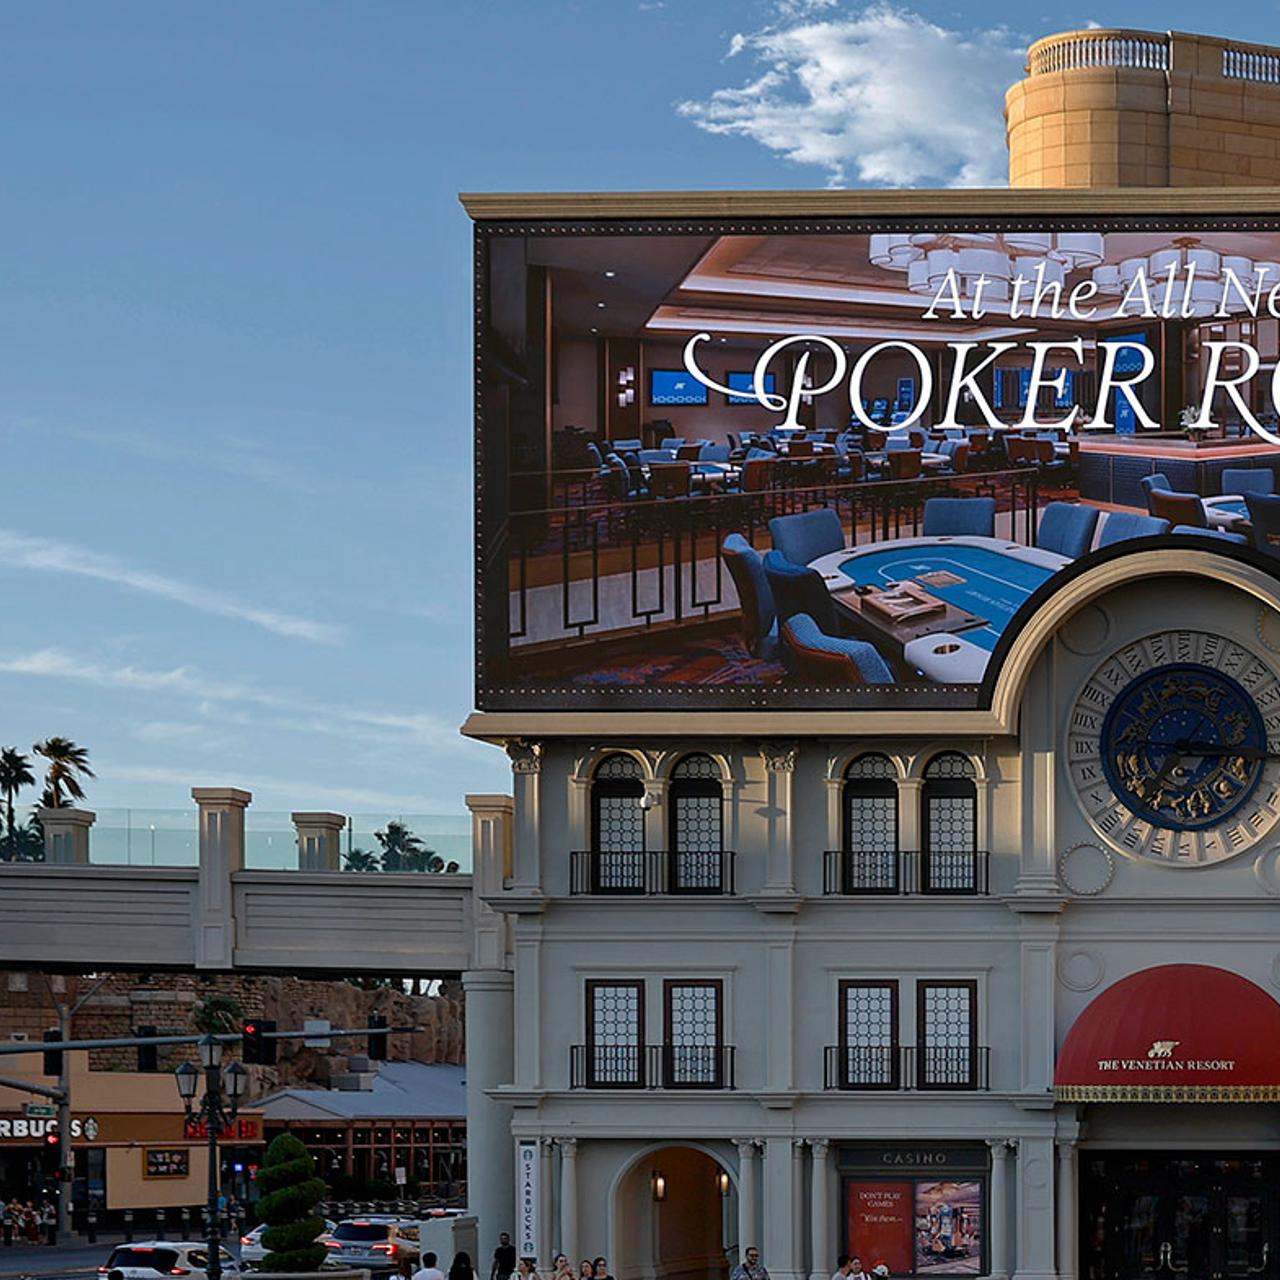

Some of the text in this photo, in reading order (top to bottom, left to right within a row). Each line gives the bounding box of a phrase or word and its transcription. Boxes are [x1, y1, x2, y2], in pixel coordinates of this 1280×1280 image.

[921, 267, 989, 320] At
[1008, 264, 1098, 320] the
[1112, 260, 1196, 320] All
[683, 333, 1160, 432] POKER
[1097, 1059, 1236, 1071] THE VENETIAN RESORT
[0, 1119, 82, 1138] RBUCS
[883, 1153, 946, 1164] CASINO
